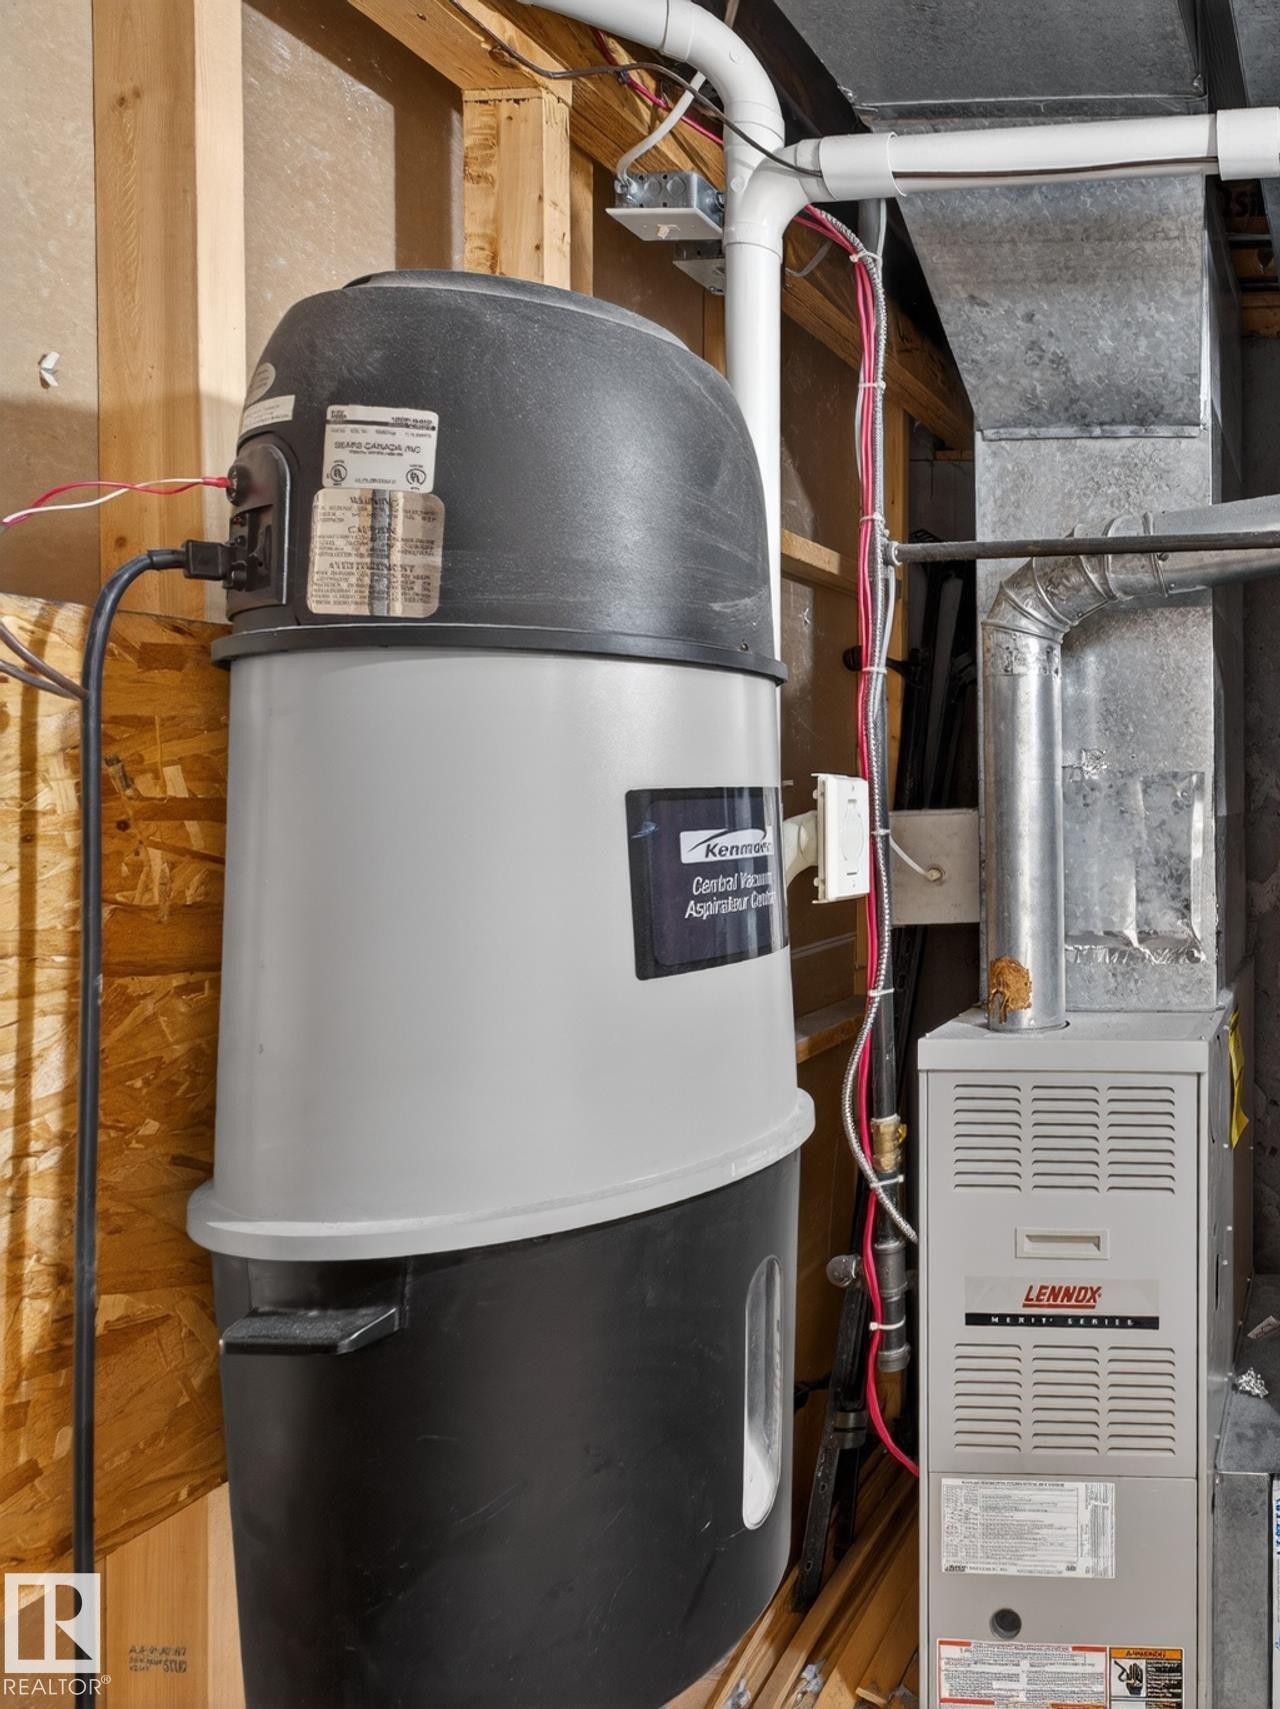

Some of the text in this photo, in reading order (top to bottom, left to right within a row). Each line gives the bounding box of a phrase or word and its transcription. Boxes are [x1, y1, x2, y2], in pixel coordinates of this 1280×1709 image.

[692, 873, 738, 896] Central
[684, 895, 749, 920] Aspirateur
[1024, 1284, 1102, 1304] LENNOX
